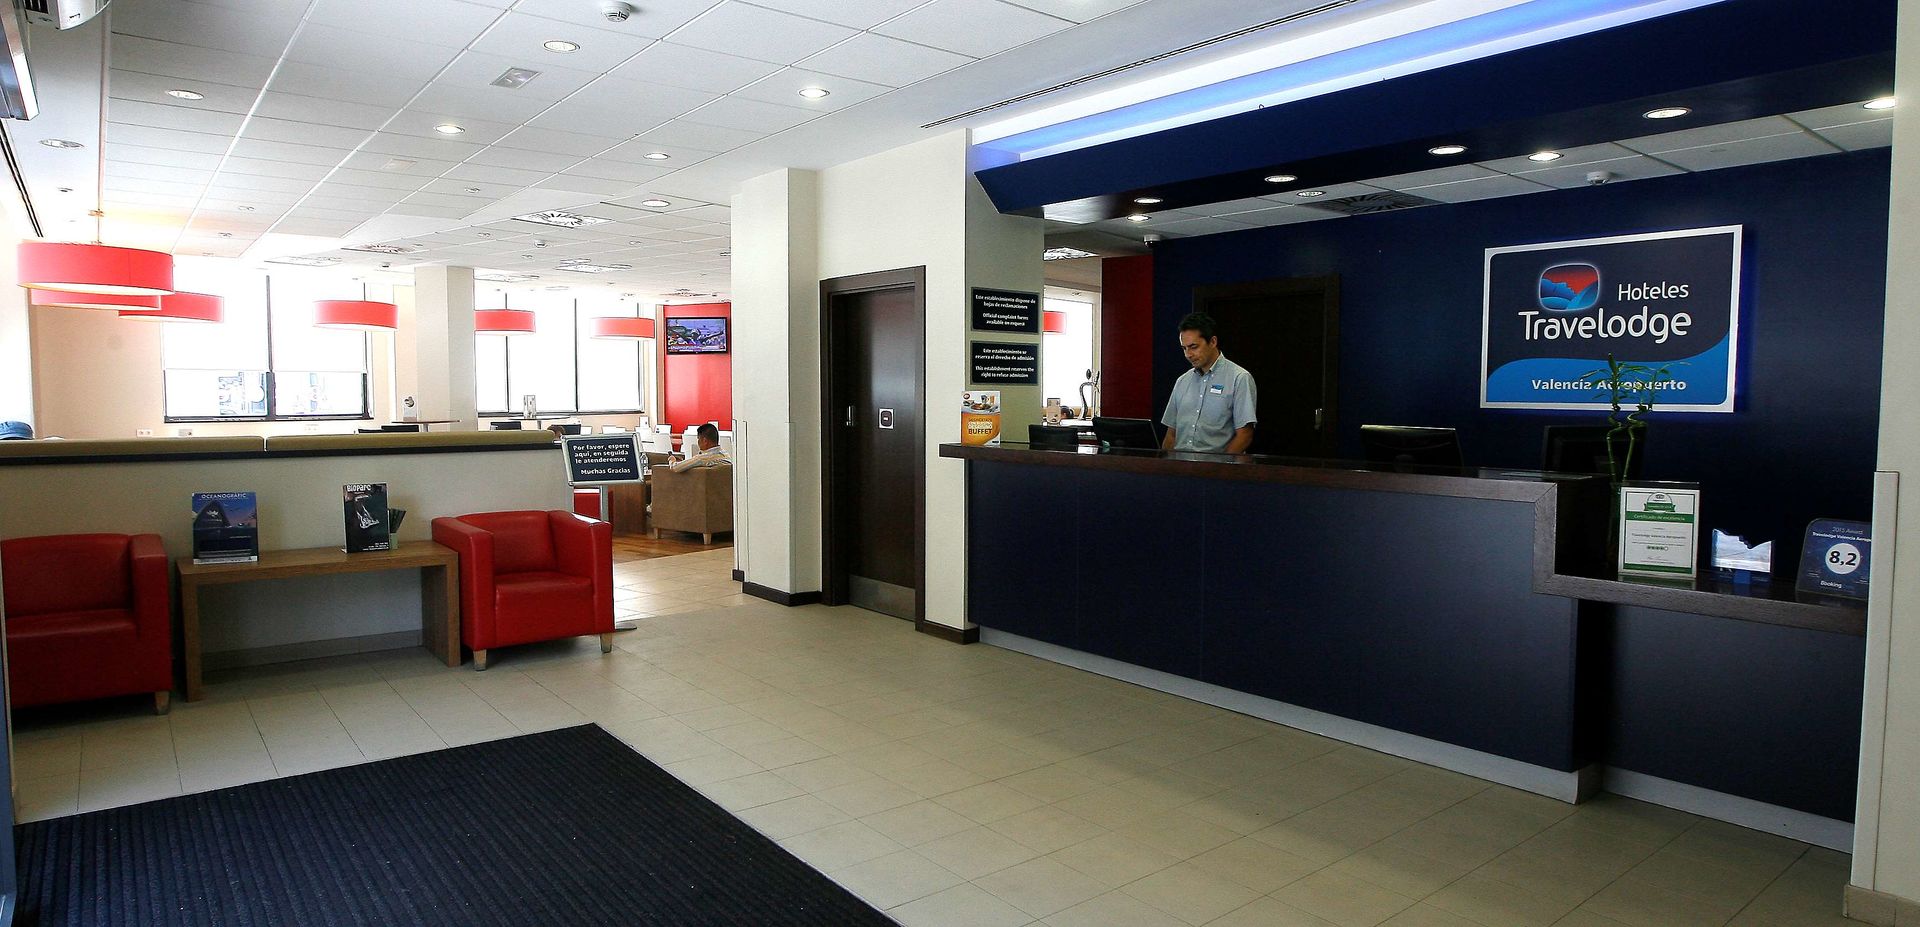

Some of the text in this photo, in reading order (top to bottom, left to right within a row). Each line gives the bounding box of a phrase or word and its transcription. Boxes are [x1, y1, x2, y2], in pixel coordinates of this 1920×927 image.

[1618, 281, 1689, 301] Hoteles
[1518, 306, 1692, 344] Travelodge
[1532, 378, 1592, 390] Valencia
[1829, 550, 1857, 566] 8,2
